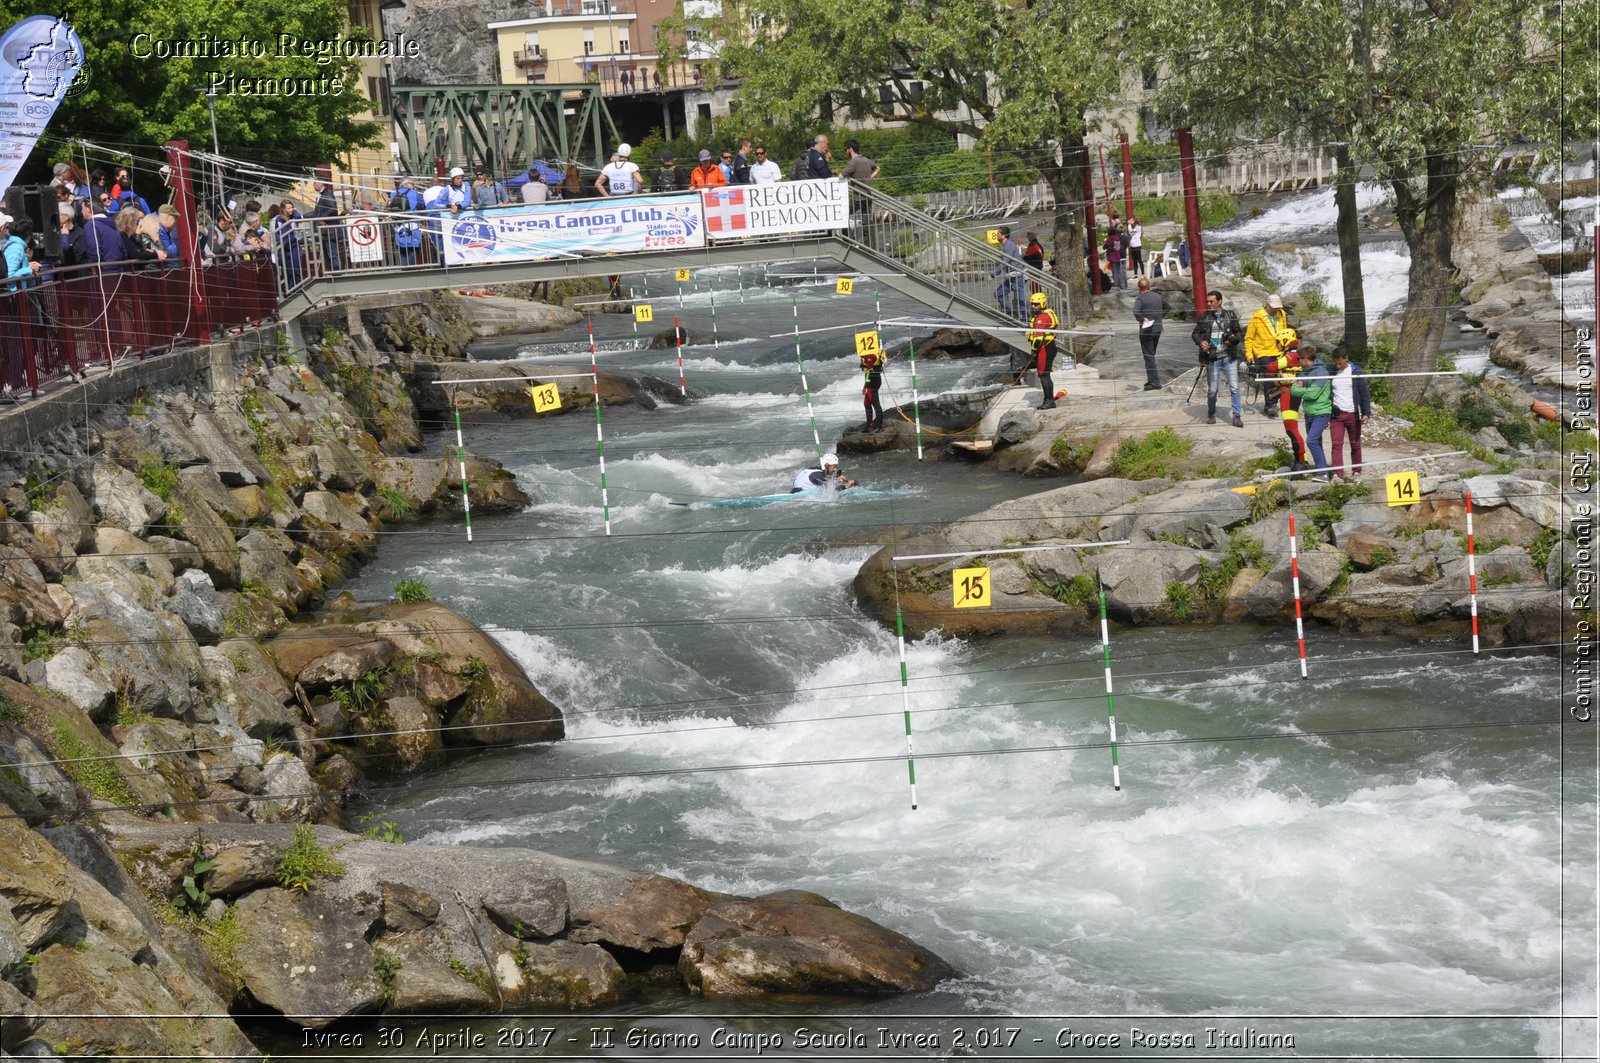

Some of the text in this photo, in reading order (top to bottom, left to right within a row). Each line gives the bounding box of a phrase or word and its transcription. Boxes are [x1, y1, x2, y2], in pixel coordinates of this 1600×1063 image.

[26, 106, 50, 115] BCS
[613, 182, 626, 190] 68
[748, 181, 842, 208] REGIONE
[499, 219, 551, 233] Ivrea
[555, 214, 616, 229] Canoa
[621, 207, 663, 223] Club
[751, 204, 843, 228] PIEMONTE
[645, 236, 686, 247] Ivrea
[680, 269, 686, 279] 9
[840, 281, 850, 291] 10
[640, 308, 649, 318] 11
[860, 336, 875, 351] 12
[538, 389, 555, 405] 13
[1394, 478, 1414, 499] 14
[961, 576, 984, 600] 15
